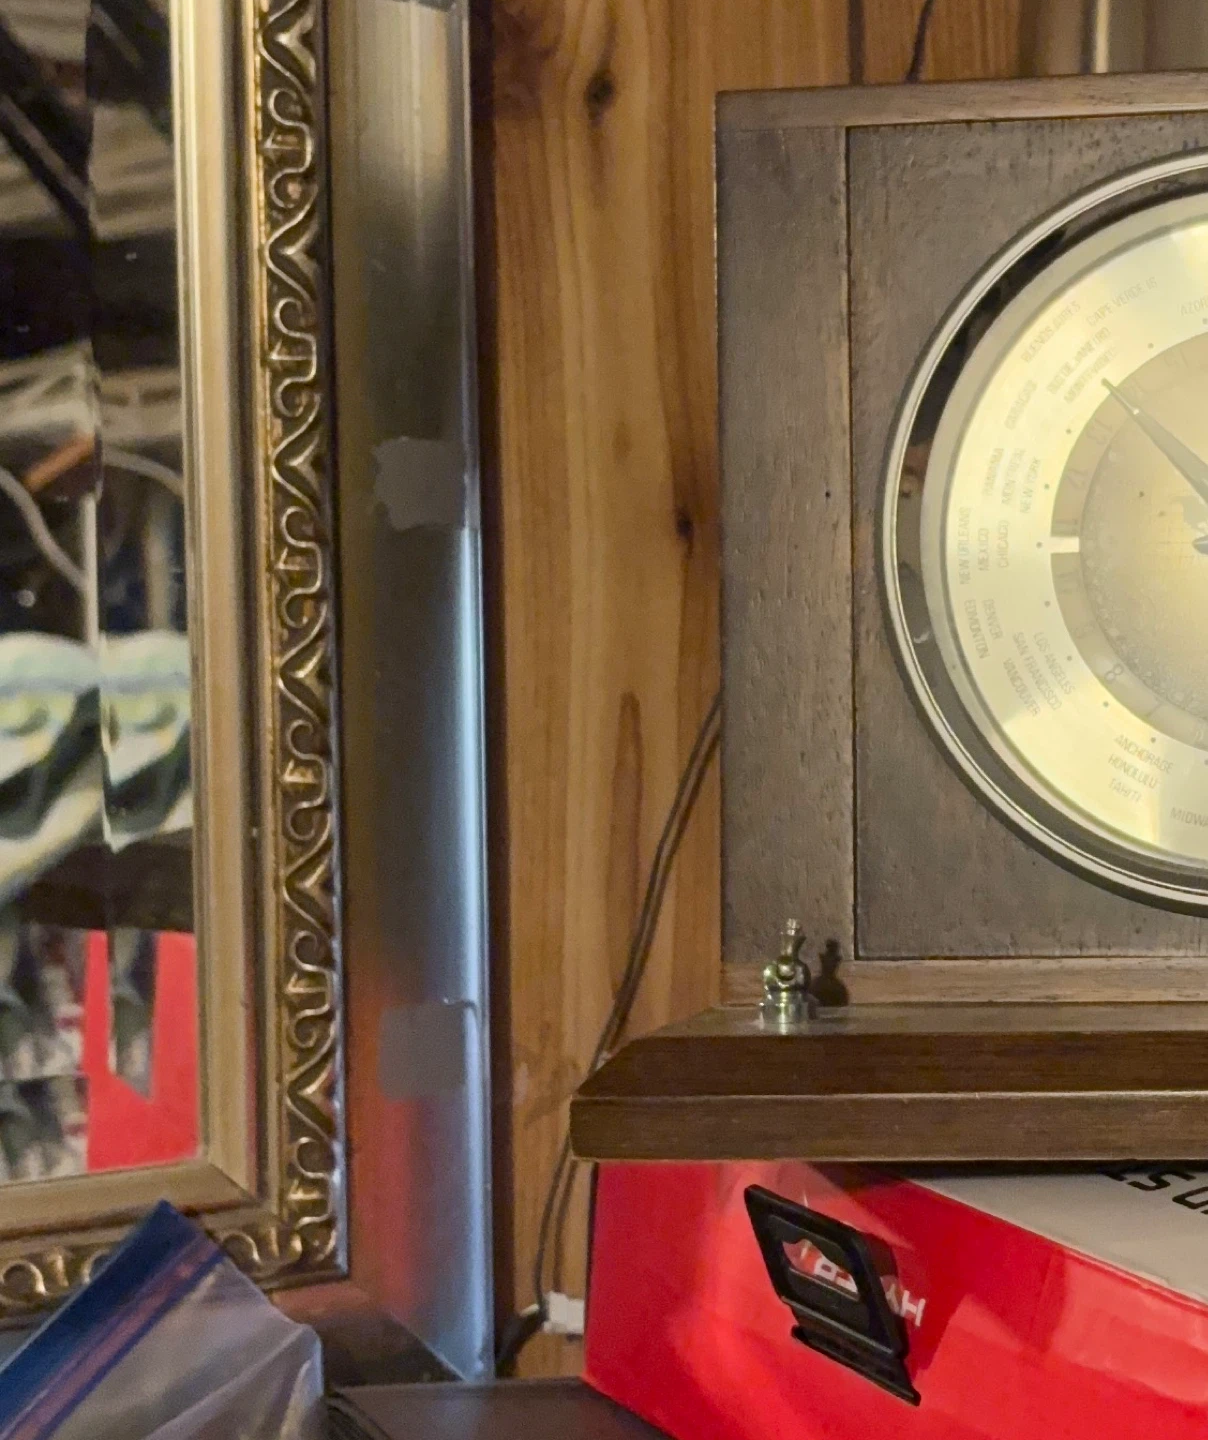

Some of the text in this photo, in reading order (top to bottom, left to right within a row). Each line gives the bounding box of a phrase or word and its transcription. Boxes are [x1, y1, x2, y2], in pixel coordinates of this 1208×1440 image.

[978, 527, 990, 572] MEXICO
[996, 519, 1010, 569] CHICAGO
[1113, 734, 1174, 775] ANCHORAGE
